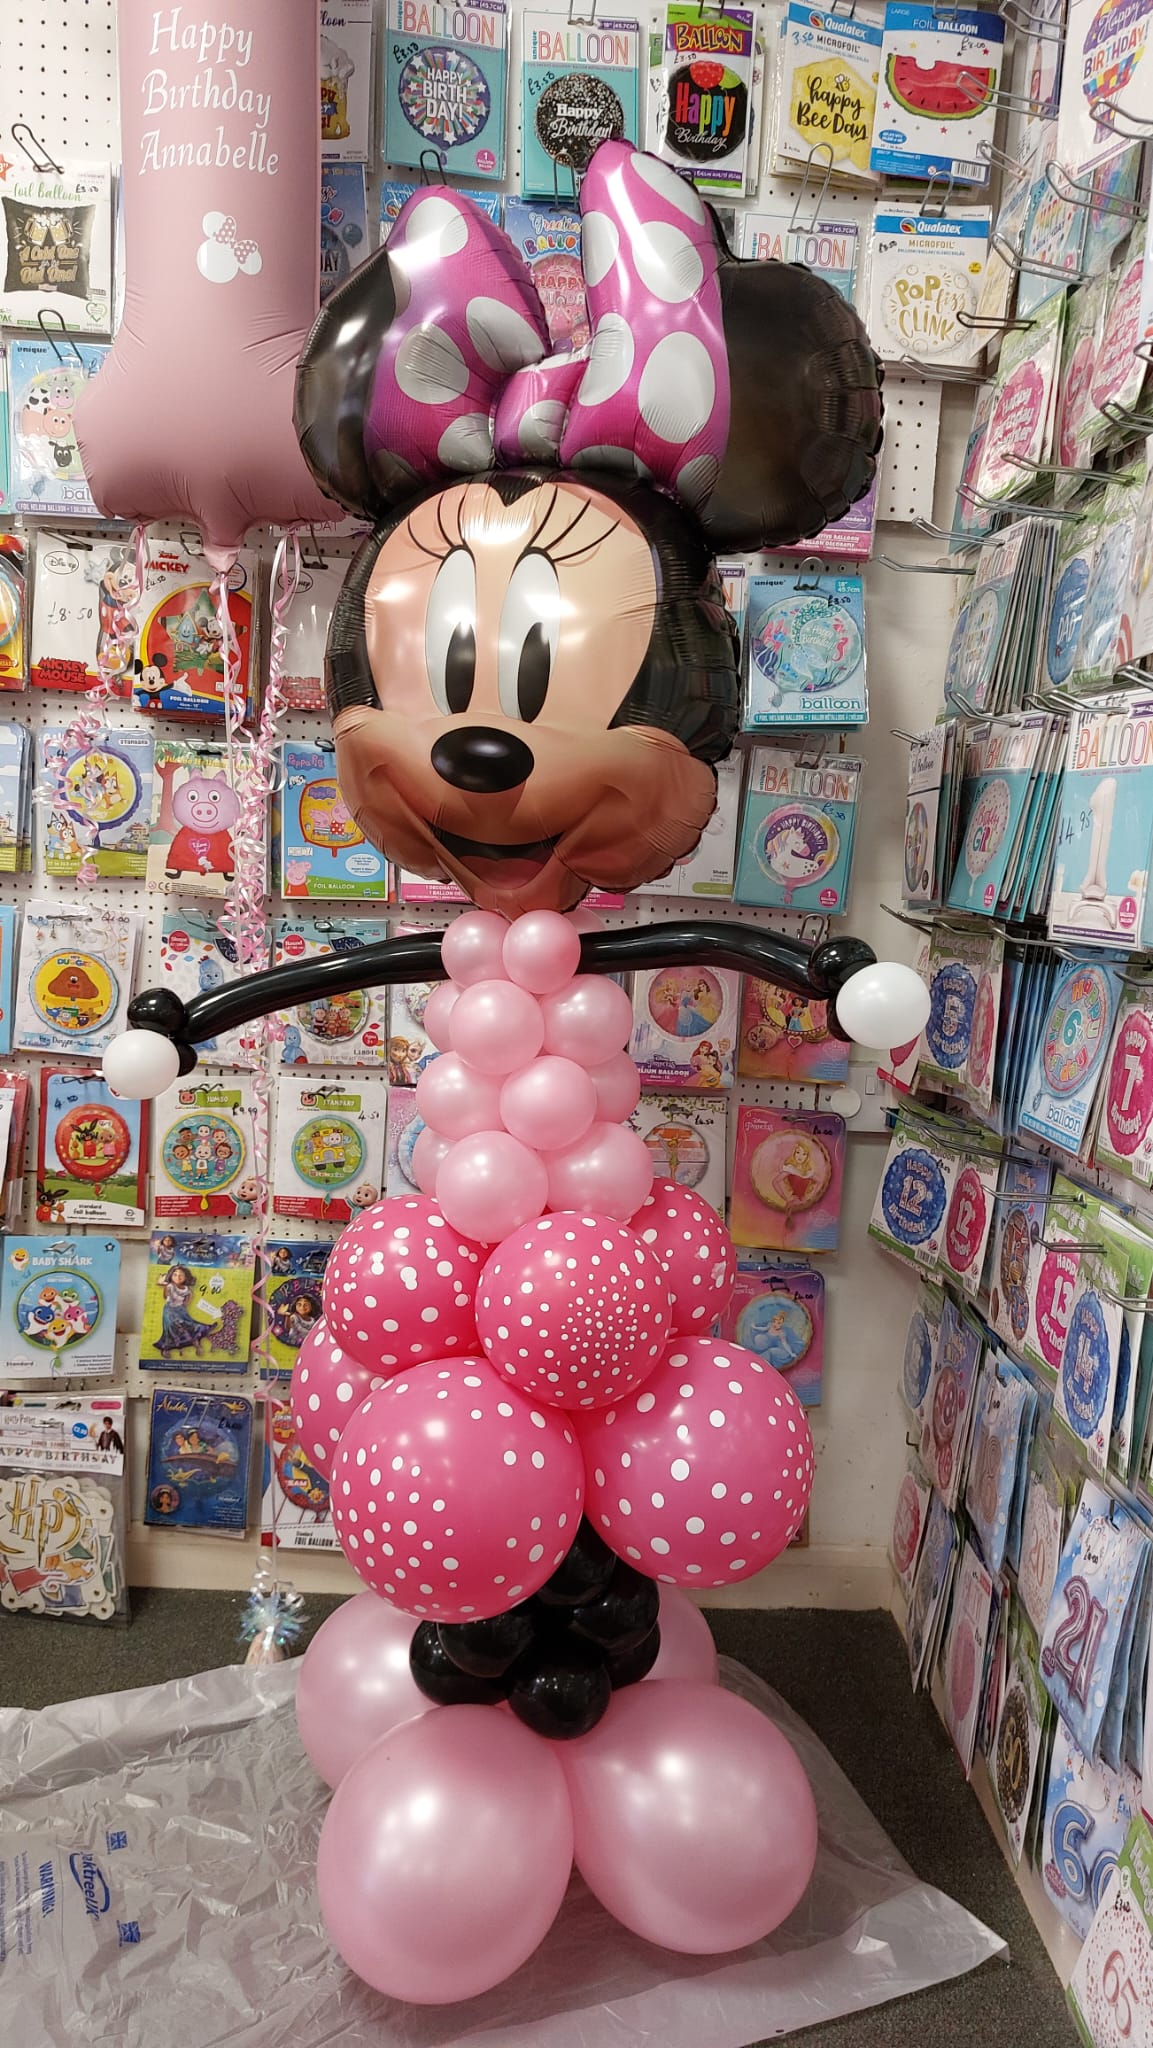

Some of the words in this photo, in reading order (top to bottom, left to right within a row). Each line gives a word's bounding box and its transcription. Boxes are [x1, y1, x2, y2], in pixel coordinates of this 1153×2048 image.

[404, 1, 496, 45] BALLOON
[824, 17, 866, 41] Qualatex
[913, 18, 934, 30] FOIL
[937, 22, 978, 34] BALLOON
[1098, 4, 1140, 41] Happy
[150, 6, 254, 67] Happy
[538, 30, 628, 66] BALLOON
[675, 23, 744, 52] BALLOON
[816, 34, 859, 54] MICROFOIL
[1084, 20, 1149, 79] BIRTHDAY!
[427, 68, 464, 84] HAPPY
[141, 68, 272, 128] Birthday
[423, 82, 466, 104] BIRTH
[807, 76, 864, 120] happy
[426, 102, 464, 122] DAY!
[556, 104, 602, 120] Happy
[675, 82, 736, 137] Happy
[550, 120, 612, 138] Birthday!
[797, 102, 830, 129] Bee
[832, 112, 868, 142] Day
[138, 126, 280, 176] Annabelle
[674, 127, 728, 152] Birthday
[38, 182, 81, 202] balloon
[918, 221, 962, 236] Qualatex
[908, 239, 954, 249] MICROFOIL
[895, 274, 941, 306] POP
[935, 290, 966, 314] fizz
[898, 310, 956, 342] CLINK
[144, 560, 190, 573] MICKEY
[38, 656, 88, 672] MICKEY
[38, 669, 86, 684] MOUSE
[802, 697, 860, 710] balloon
[288, 754, 310, 768] Peppa
[312, 754, 324, 770] Pig
[764, 766, 849, 800] BALLOON
[1062, 1008, 1082, 1046] 6
[658, 1069, 690, 1077] BALLOON
[323, 1098, 354, 1107] STANDARD
[1046, 1106, 1082, 1134] balloon
[906, 1158, 934, 1178] Happy
[900, 1176, 928, 1216] 12
[32, 1257, 56, 1266] BABY
[58, 1256, 93, 1266] SHARK
[1056, 1254, 1078, 1277] Happ
[1051, 1275, 1074, 1329] 13
[1040, 1312, 1065, 1352] Birthd
[157, 1395, 188, 1413] Aladdin
[294, 1536, 306, 1545] FOIL
[308, 1538, 333, 1546] BALLOON
[1054, 1574, 1108, 1714] 21
[1102, 1950, 1139, 2039] 65
